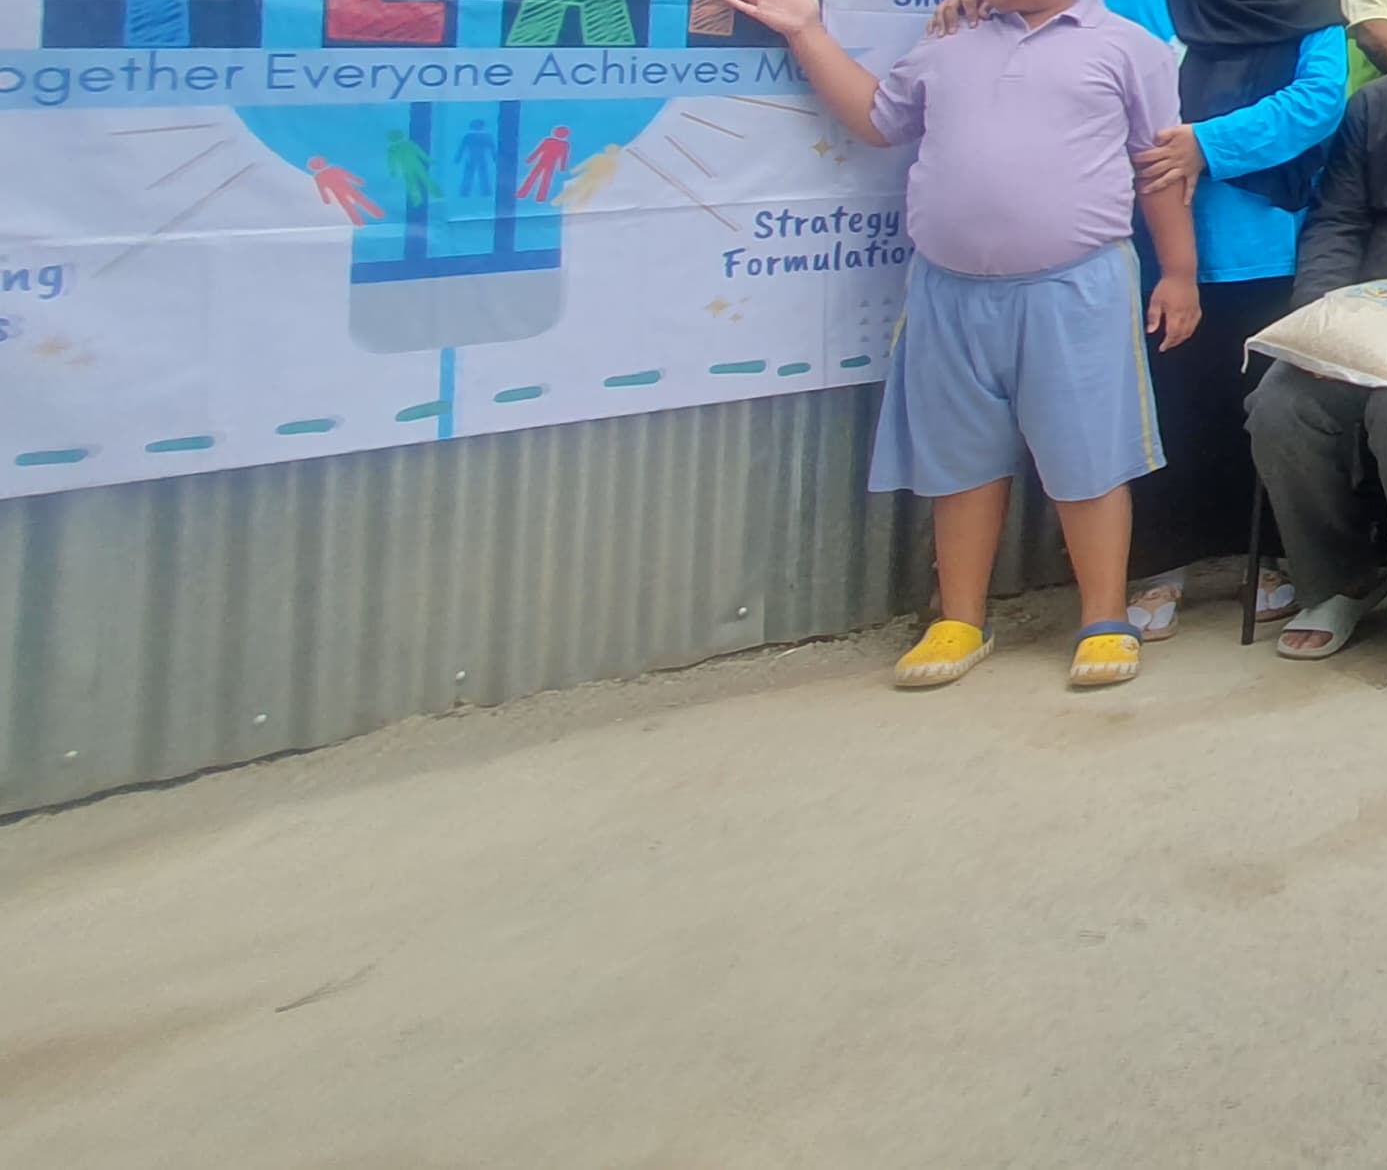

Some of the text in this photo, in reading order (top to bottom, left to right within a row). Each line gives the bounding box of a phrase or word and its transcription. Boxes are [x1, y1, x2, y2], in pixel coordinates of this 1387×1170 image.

[0, 51, 244, 106] ogether
[267, 53, 513, 100] Everyone
[533, 50, 740, 86] Achieves
[754, 206, 900, 239] Strategy
